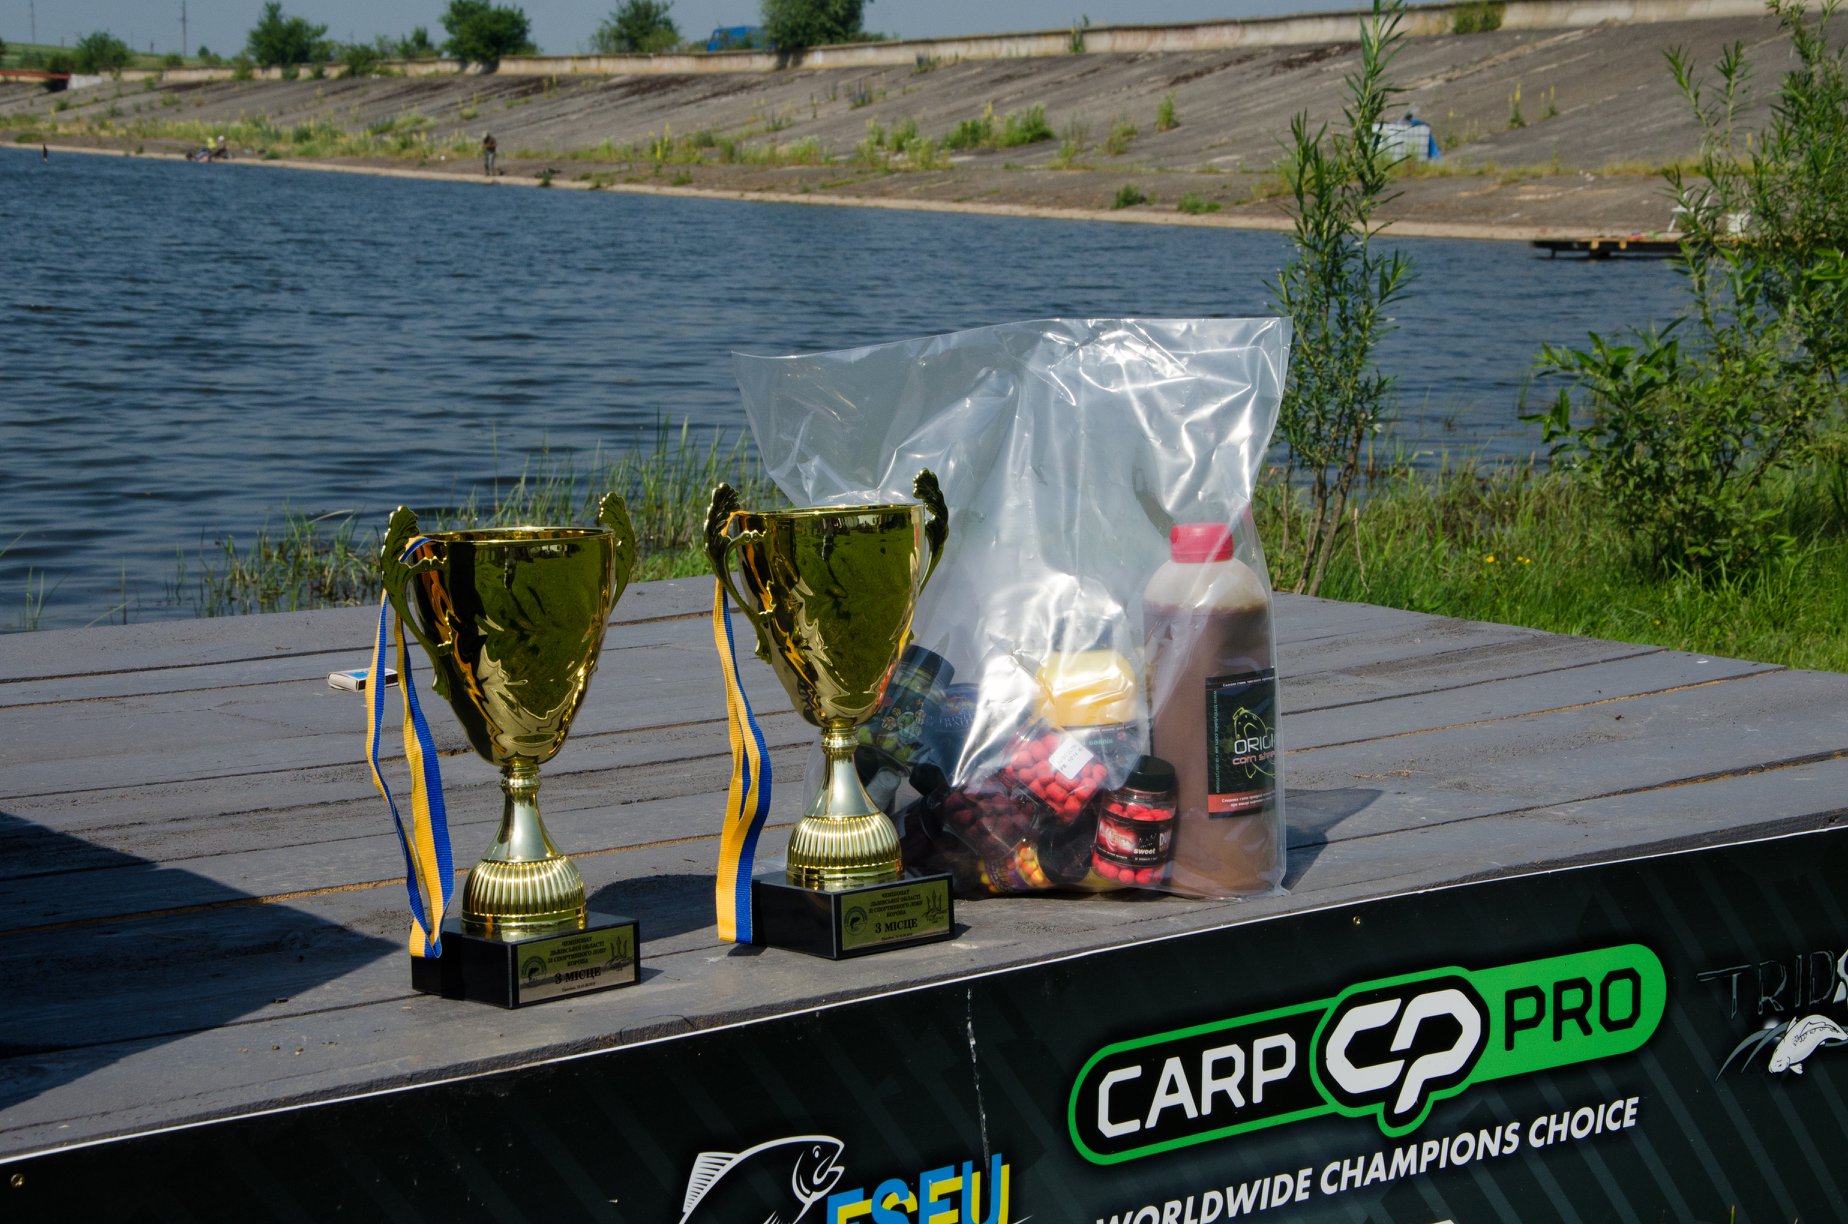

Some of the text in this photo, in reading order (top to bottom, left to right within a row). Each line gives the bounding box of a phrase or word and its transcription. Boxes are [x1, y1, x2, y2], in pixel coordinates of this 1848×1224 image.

[876, 923, 882, 934] 3
[884, 919, 918, 933] МІСЦЕ
[556, 967, 601, 985] 3 МІСЦЕ
[1097, 1032, 1296, 1139] CARP
[1504, 966, 1642, 1052] PRO
[1319, 1121, 1521, 1196] CHAMPIONS
[1528, 1096, 1640, 1148] CHOICE
